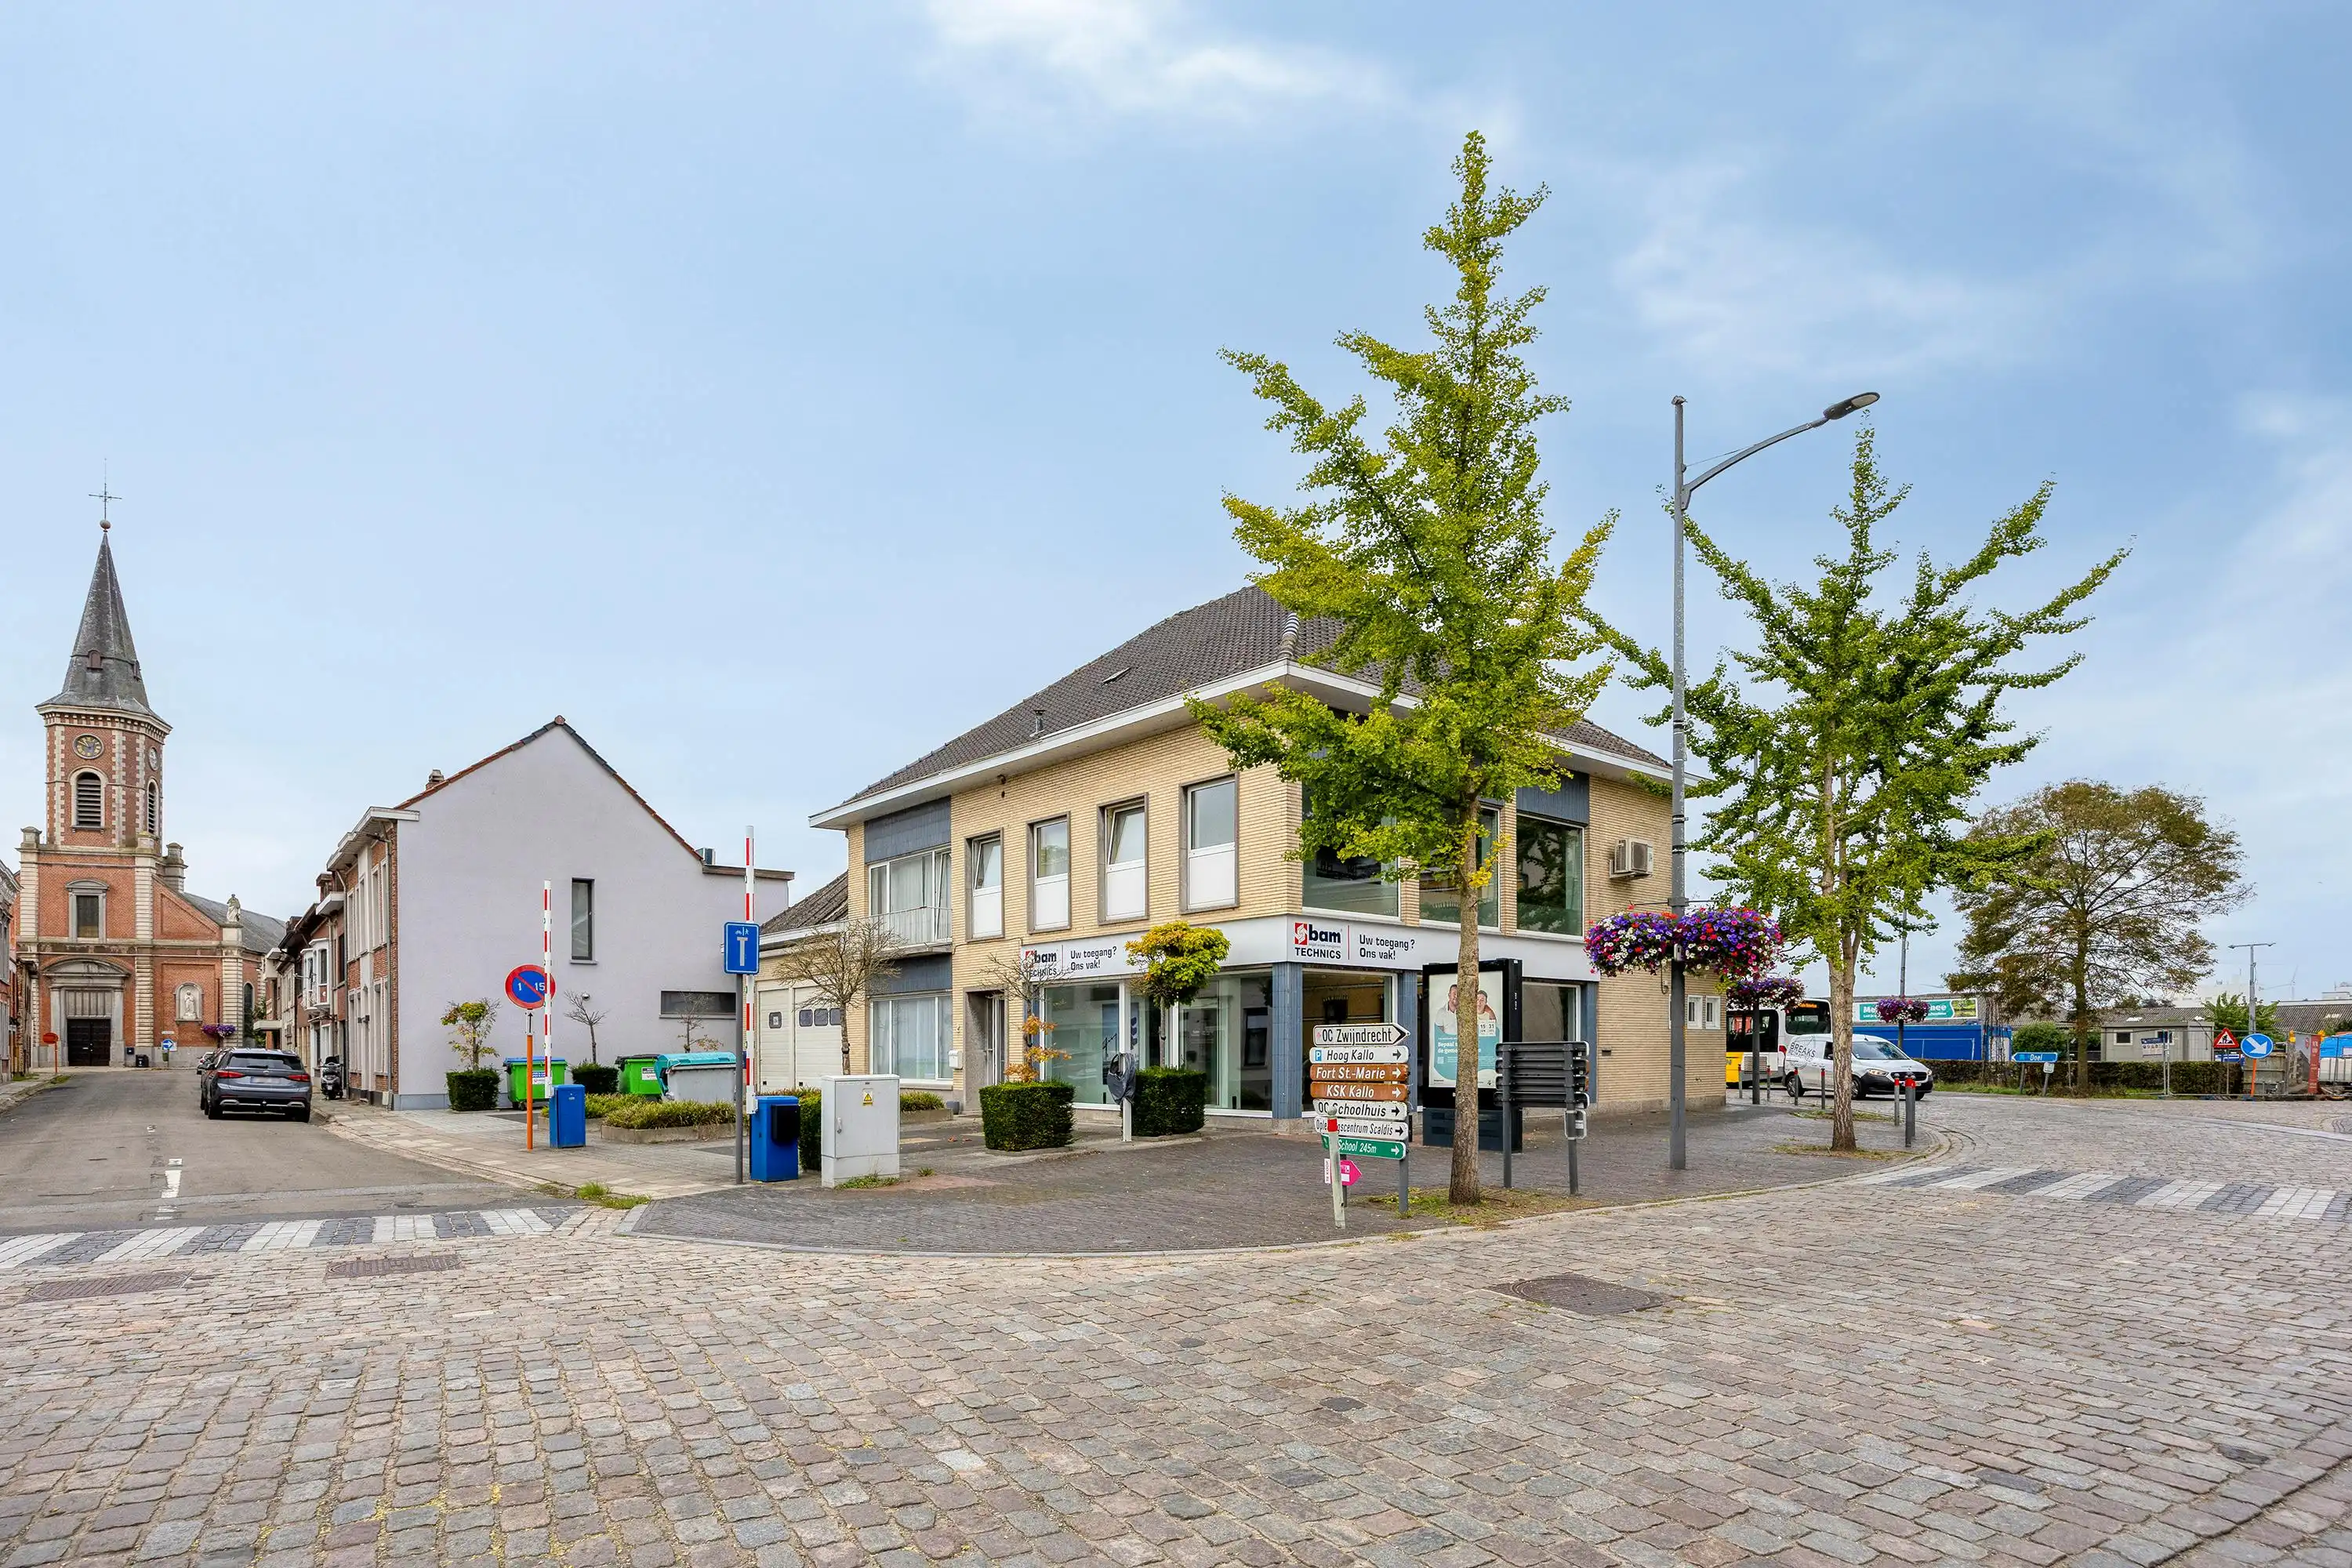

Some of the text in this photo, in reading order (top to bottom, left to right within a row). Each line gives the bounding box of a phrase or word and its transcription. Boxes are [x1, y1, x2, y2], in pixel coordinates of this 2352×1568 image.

[1308, 924, 1341, 943] bam
[1359, 935, 1373, 945] Uw
[1035, 950, 1057, 964] bam
[1070, 946, 1117, 959] Uw toegang?
[1294, 947, 1341, 959] TECHNICS
[1359, 948, 1396, 960] Ons vak!
[1070, 960, 1101, 971] Ons vak!
[1029, 967, 1057, 978] ECHNICS
[517, 982, 545, 991] 1 15
[1322, 1028, 1392, 1045] OC Zwijndrecht
[1327, 1050, 1348, 1063] Hoog
[1351, 1050, 1374, 1061] Kallo
[1790, 1042, 1816, 1058] BREAKS
[1316, 1066, 1386, 1080] Fort St.-Marie
[1327, 1084, 1374, 1098] KSK Kallo
[1316, 1119, 1393, 1136] Oplegscentrum Scaldis
[1338, 1139, 1377, 1154] School 245m
